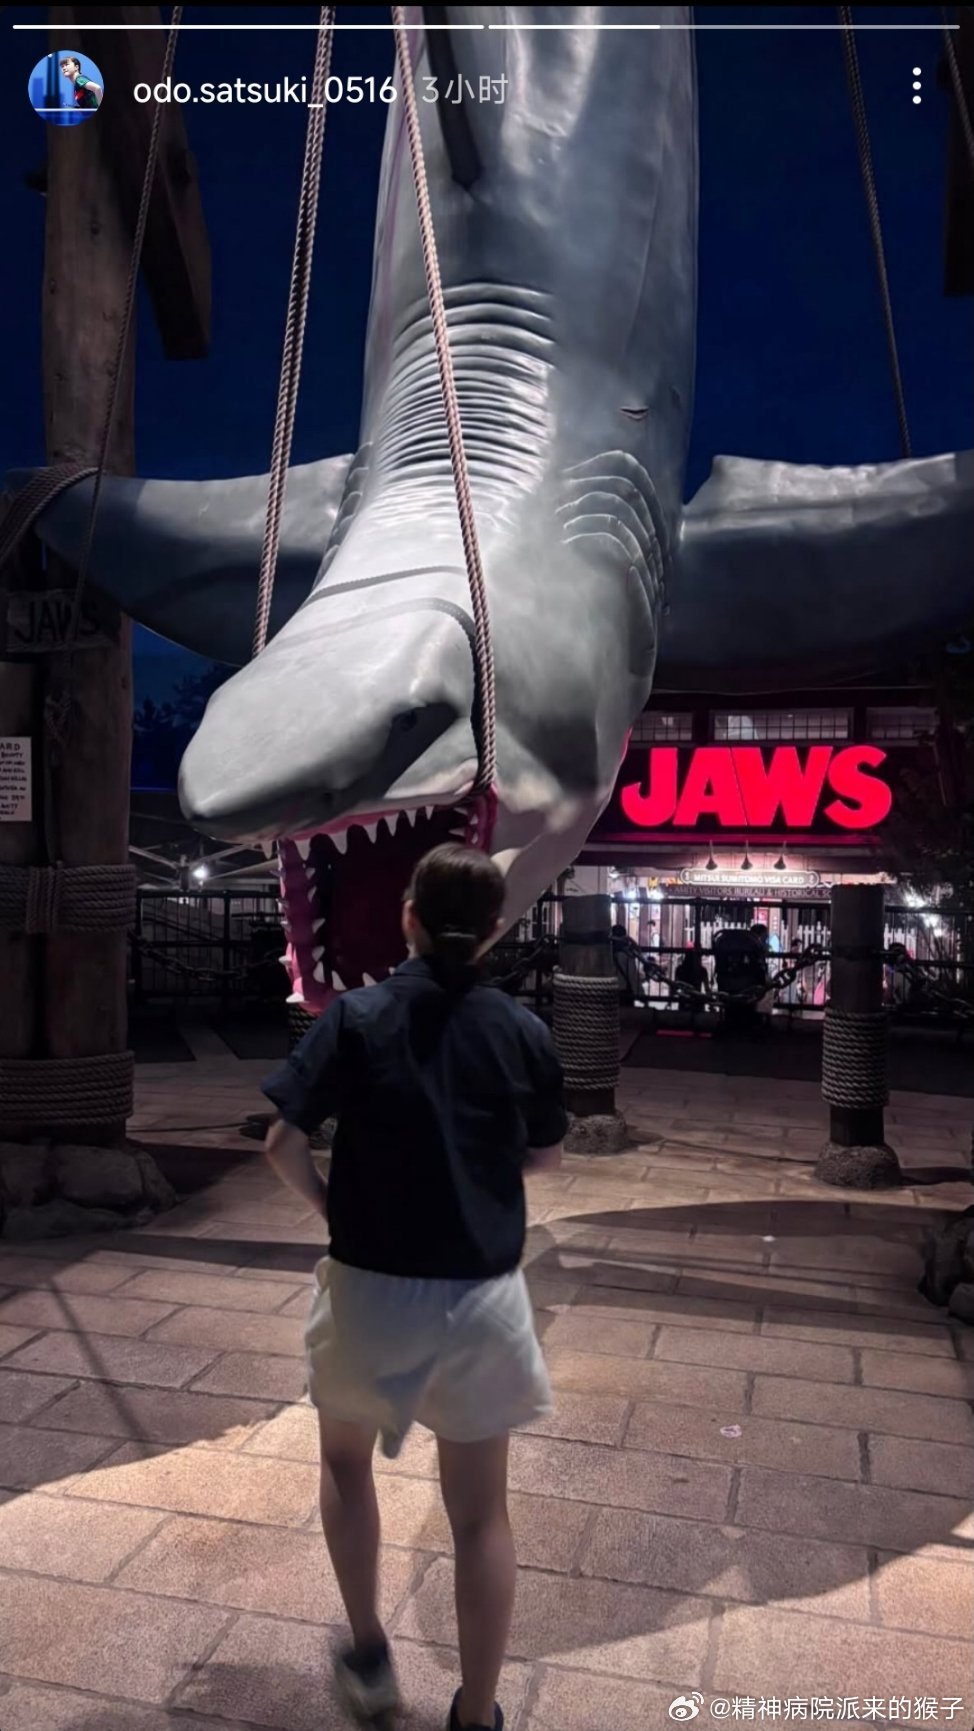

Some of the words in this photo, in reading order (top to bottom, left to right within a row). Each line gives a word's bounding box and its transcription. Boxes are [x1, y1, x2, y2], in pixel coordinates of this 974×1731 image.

[621, 745, 892, 829] JAWS
[764, 875, 781, 883] VISA
[782, 876, 804, 884] CARD
[700, 887, 731, 896] VISITORS
[734, 887, 765, 897] BUREAU
[775, 888, 819, 898] HISTORICAL
